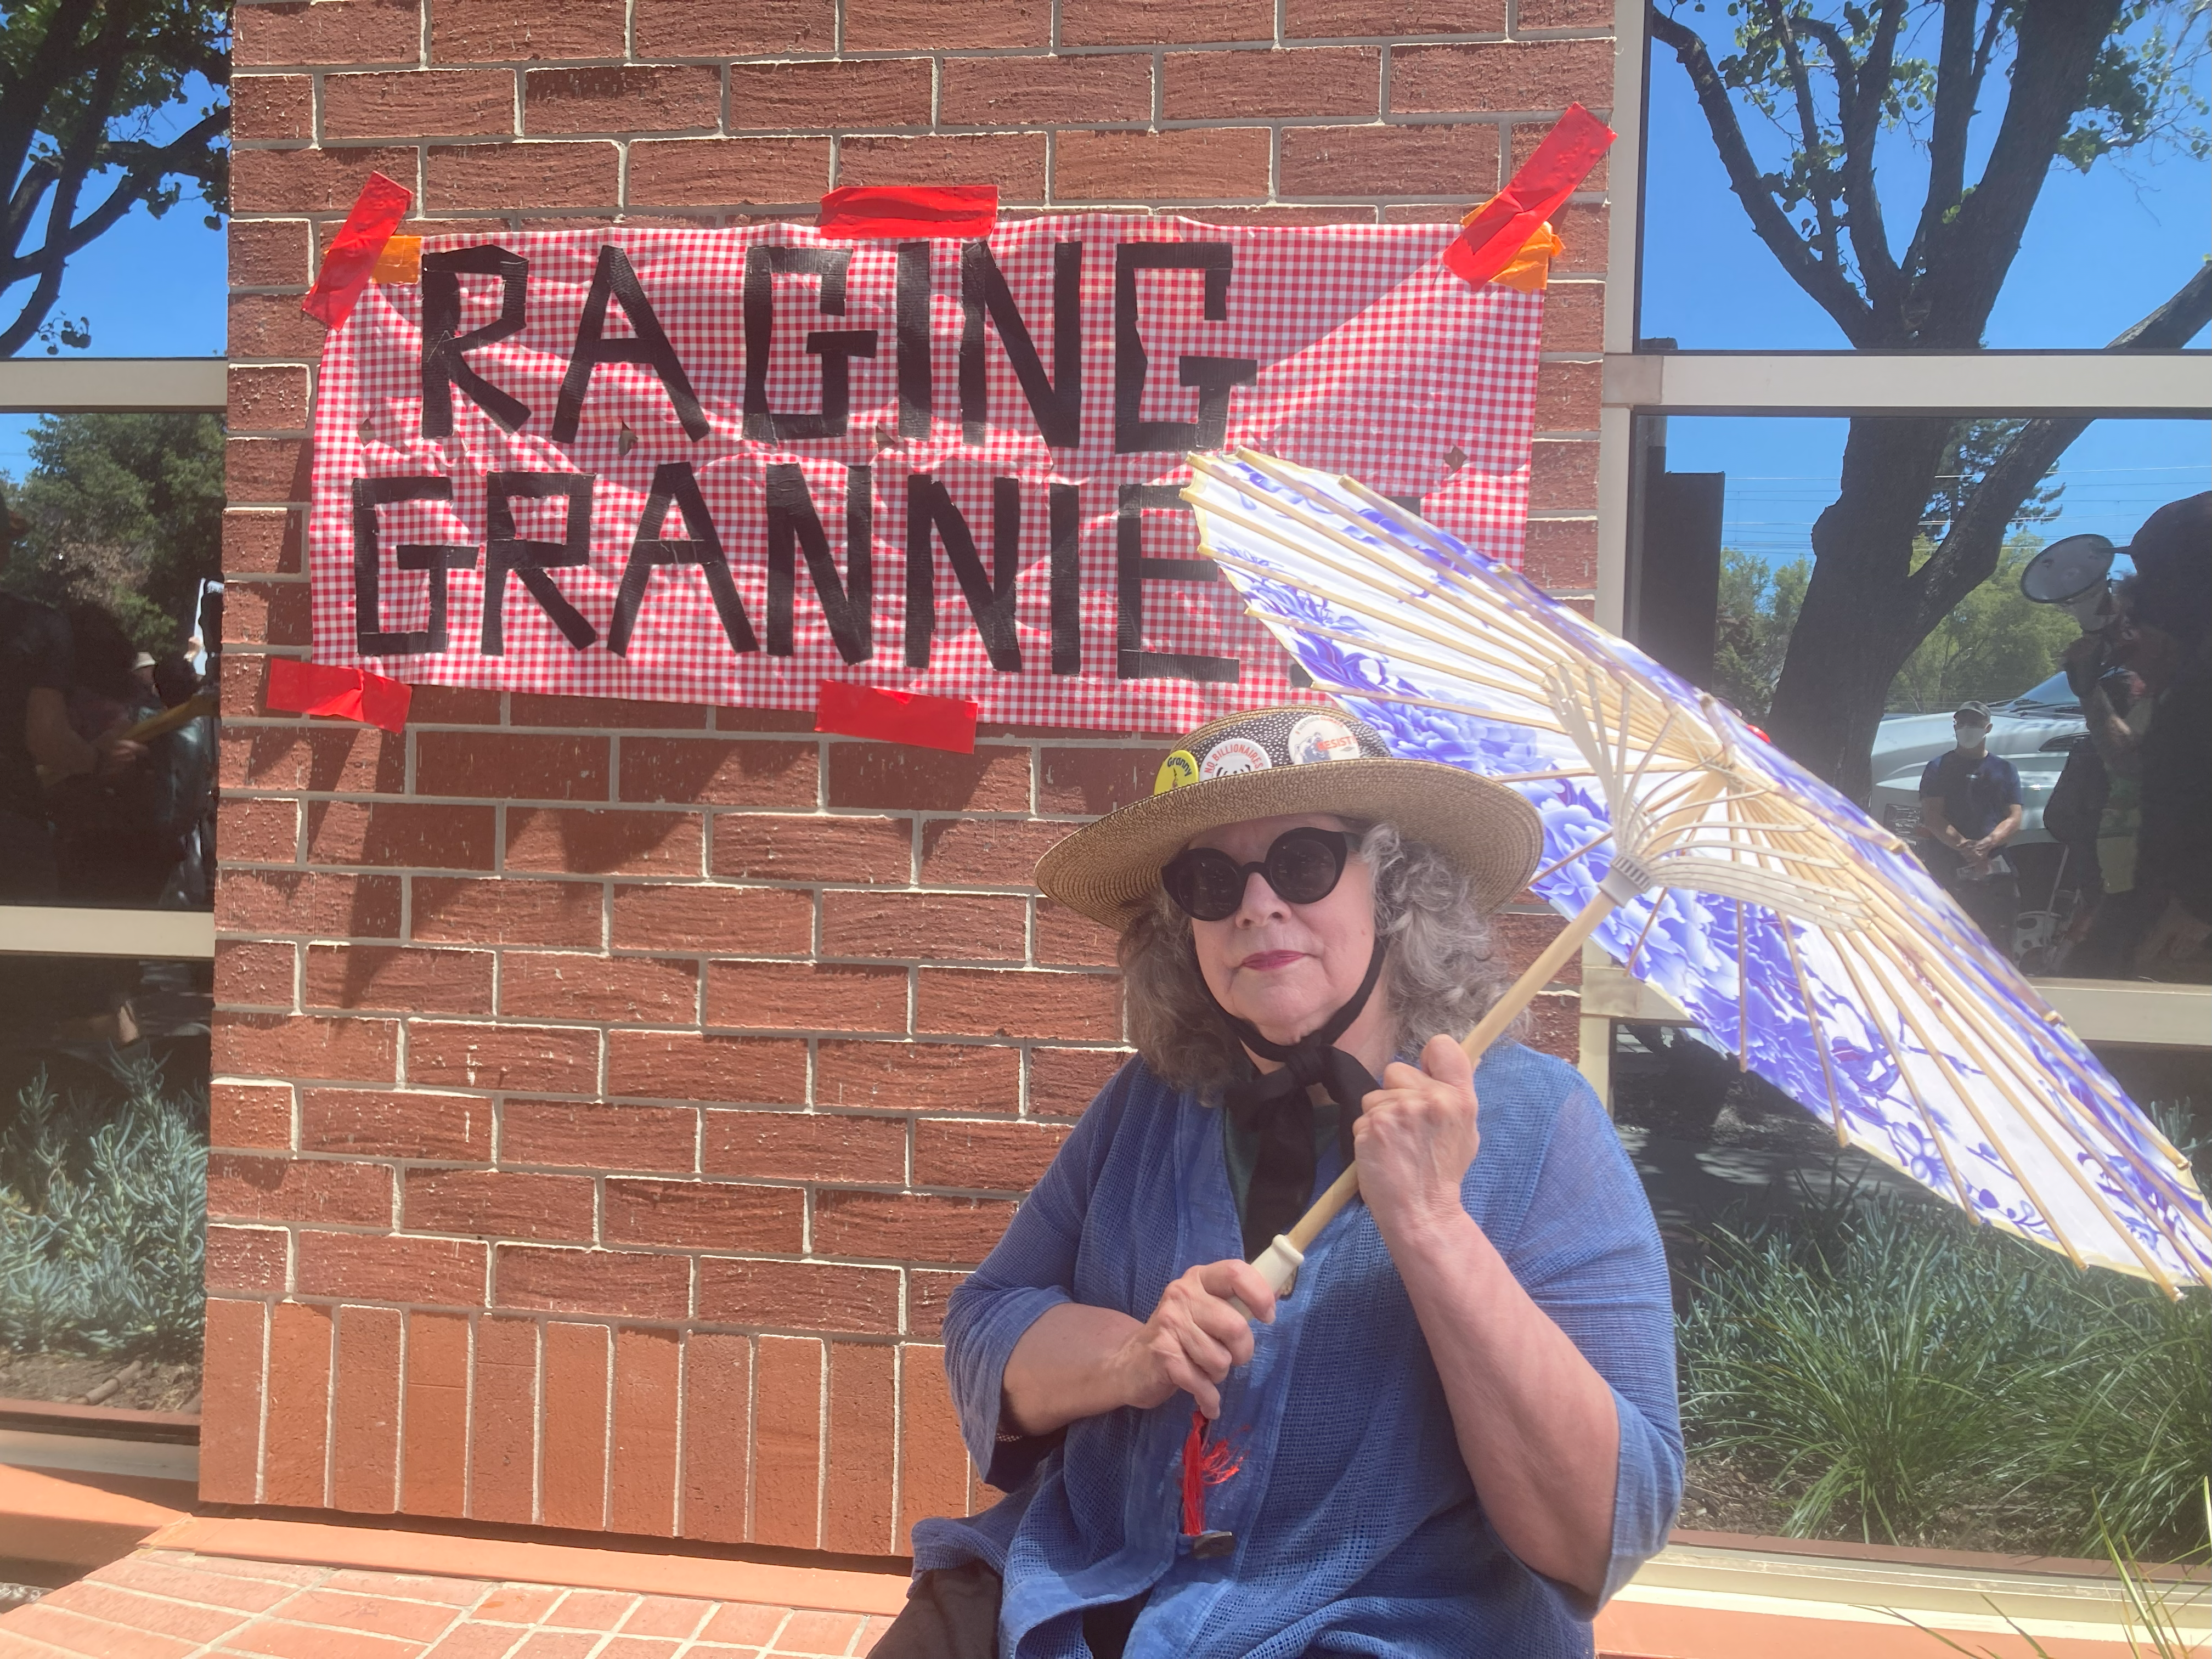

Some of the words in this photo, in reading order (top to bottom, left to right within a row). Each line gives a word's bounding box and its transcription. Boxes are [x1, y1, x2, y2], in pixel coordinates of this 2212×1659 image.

[421, 241, 1257, 453] RAGING
[352, 462, 1421, 688] GRANNIE
[1167, 757, 1192, 777] Granny
[1204, 761, 1215, 774] NO
[1212, 744, 1263, 769] BILLIONAIRES
